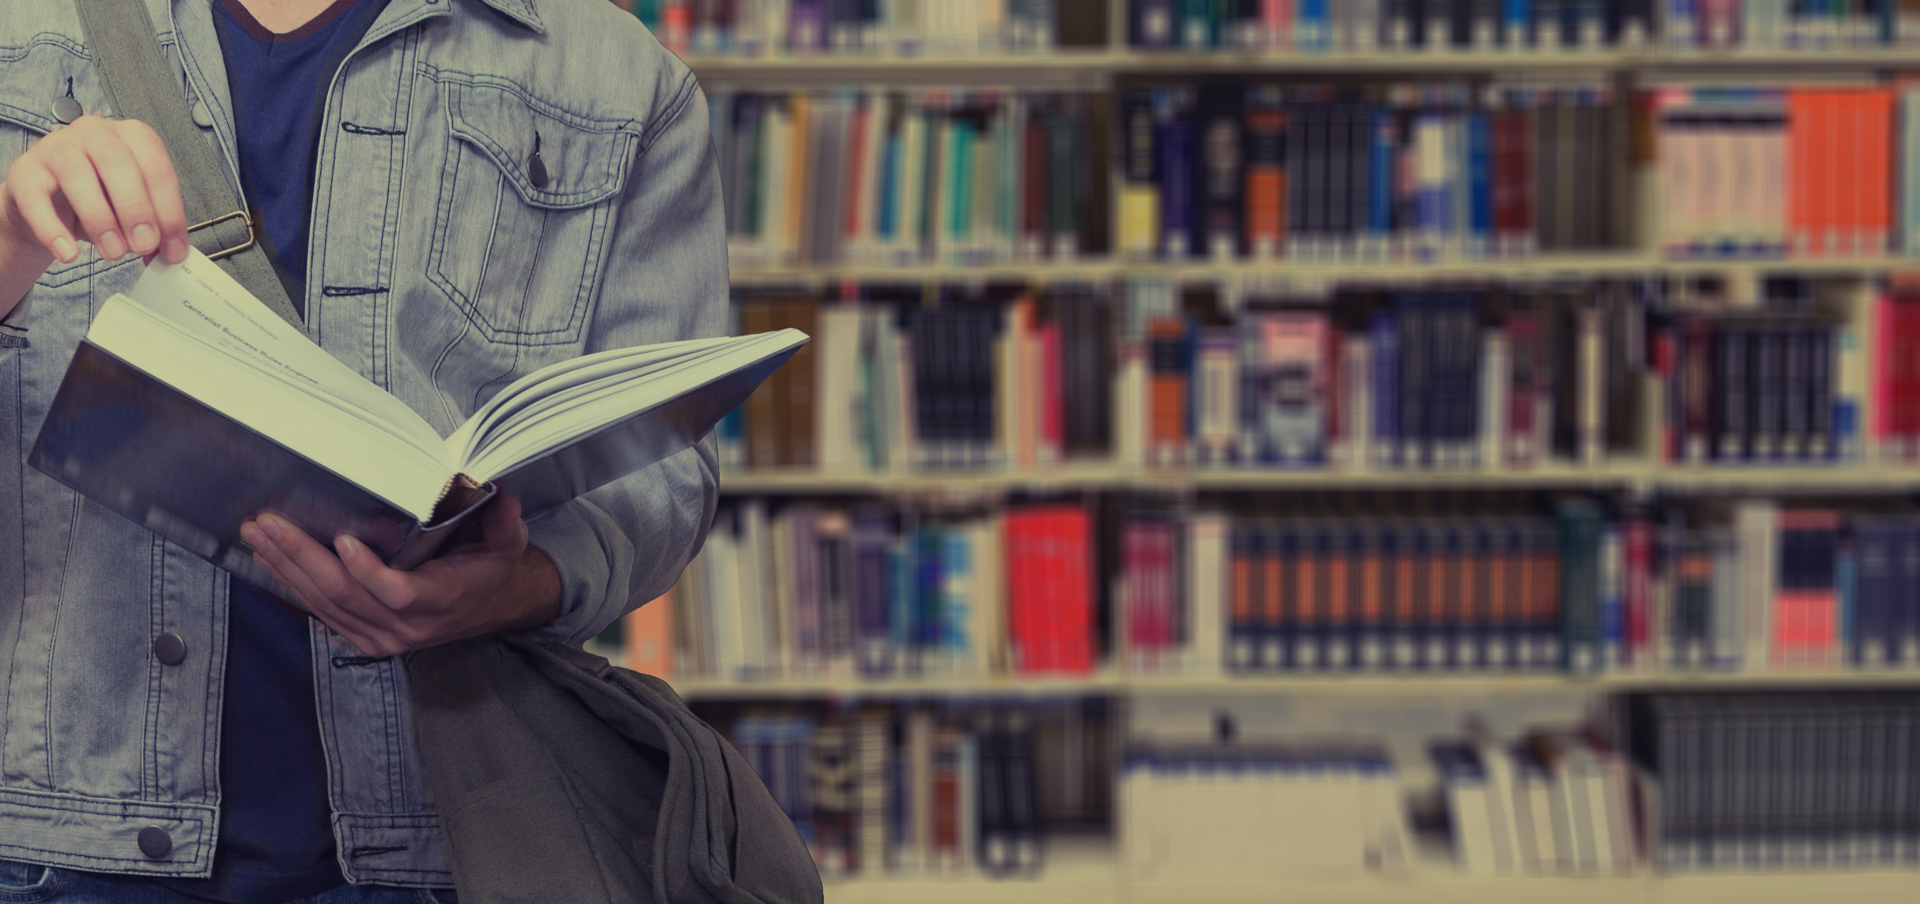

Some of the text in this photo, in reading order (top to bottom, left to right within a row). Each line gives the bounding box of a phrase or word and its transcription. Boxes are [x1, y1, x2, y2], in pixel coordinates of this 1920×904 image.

[183, 300, 221, 328] Centralist
[222, 327, 258, 352] Business
[260, 350, 282, 366] Rules
[284, 365, 319, 384] Engines
